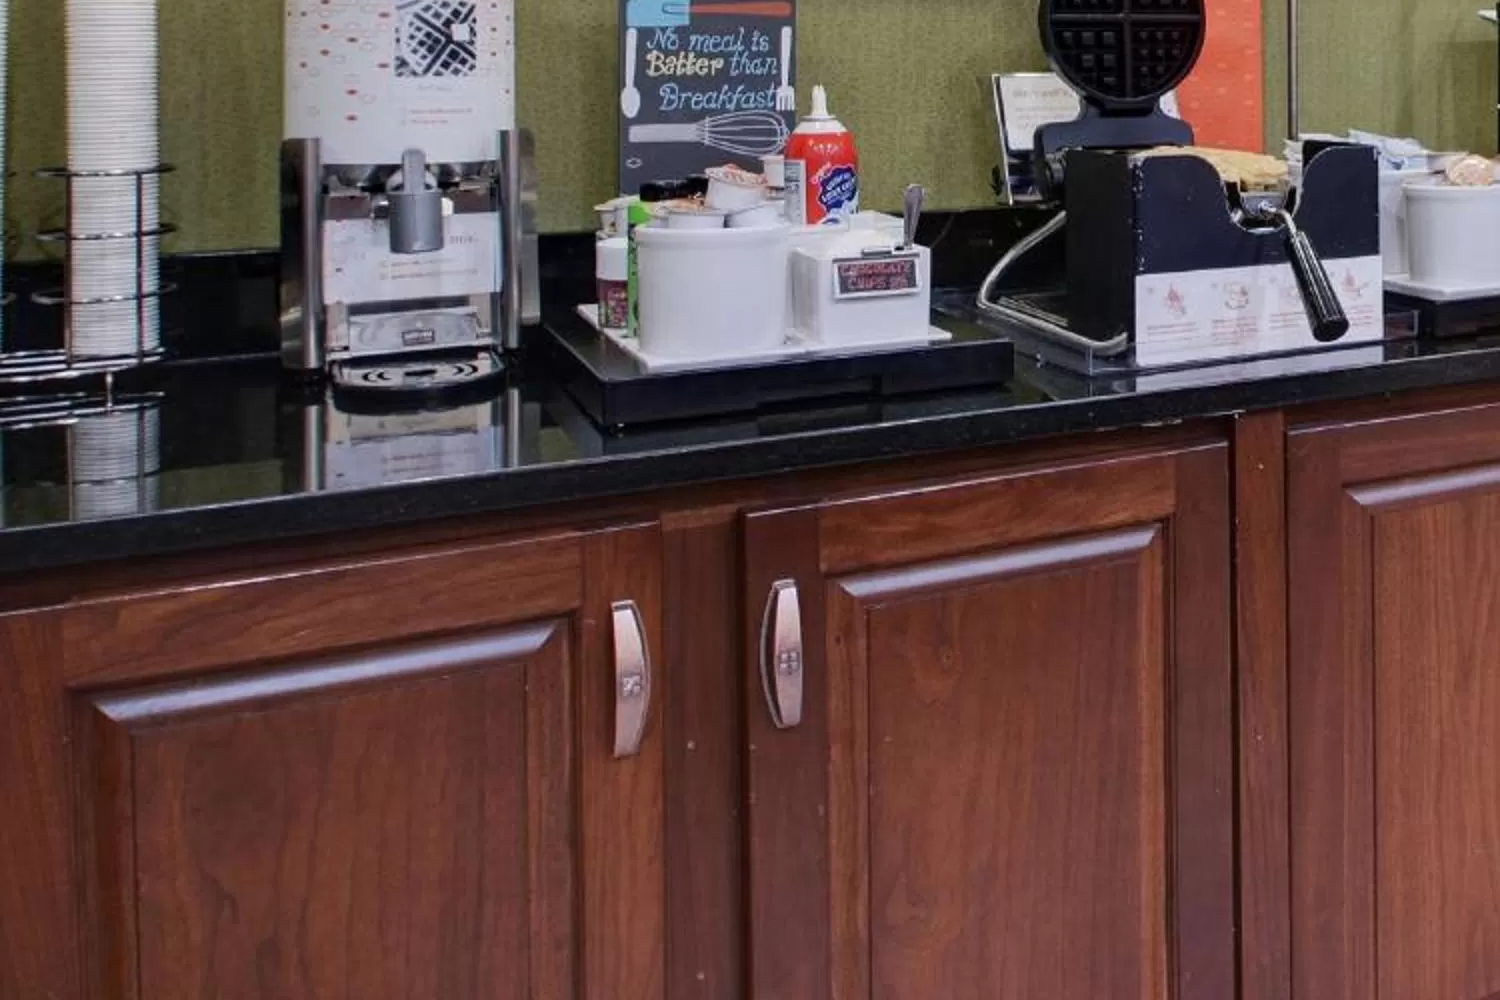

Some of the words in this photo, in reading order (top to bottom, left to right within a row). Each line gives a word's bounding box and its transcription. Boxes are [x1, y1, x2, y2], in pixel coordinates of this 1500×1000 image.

[646, 26, 679, 50] No
[688, 26, 745, 52] meal
[751, 30, 769, 52] is
[645, 50, 725, 77] Batter
[729, 50, 777, 77] than
[659, 82, 776, 111] Breakfast
